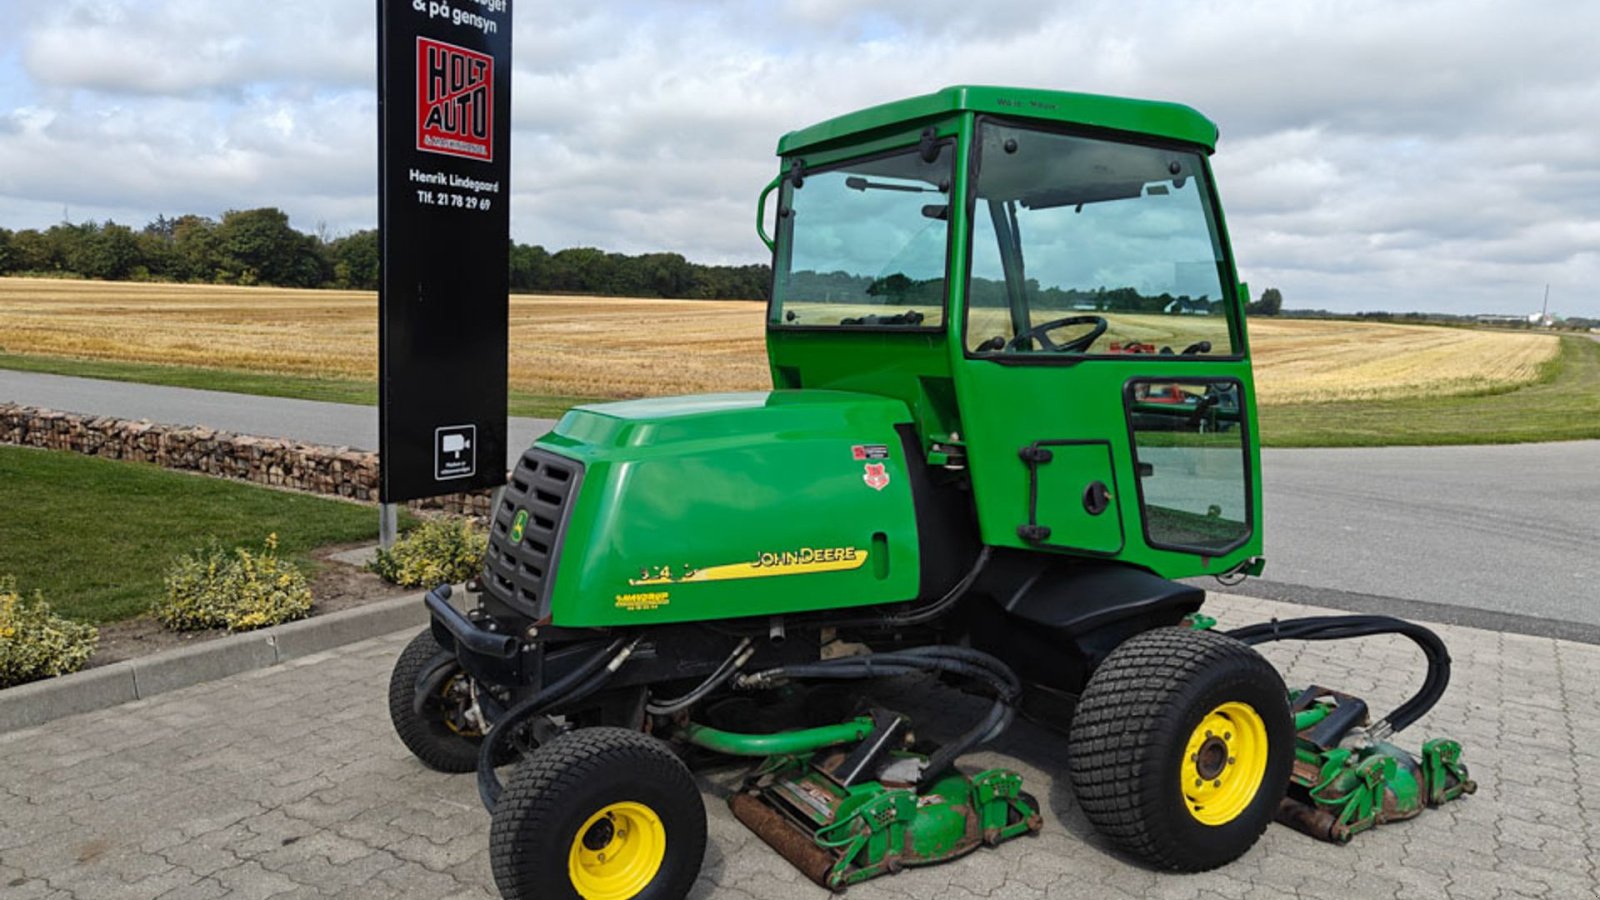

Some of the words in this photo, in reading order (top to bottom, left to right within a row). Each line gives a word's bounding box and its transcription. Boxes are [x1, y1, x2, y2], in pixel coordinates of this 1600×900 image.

[412, 0, 426, 11] &
[429, 0, 450, 18] på
[452, 8, 498, 34] gensyn
[427, 45, 488, 104] HOLT
[423, 84, 488, 140] AUTO
[409, 168, 447, 186] Henrik
[449, 173, 499, 193] Lindegaard
[437, 193, 449, 206] 21
[751, 550, 798, 568] JOHN
[800, 546, 856, 565] DEERE
